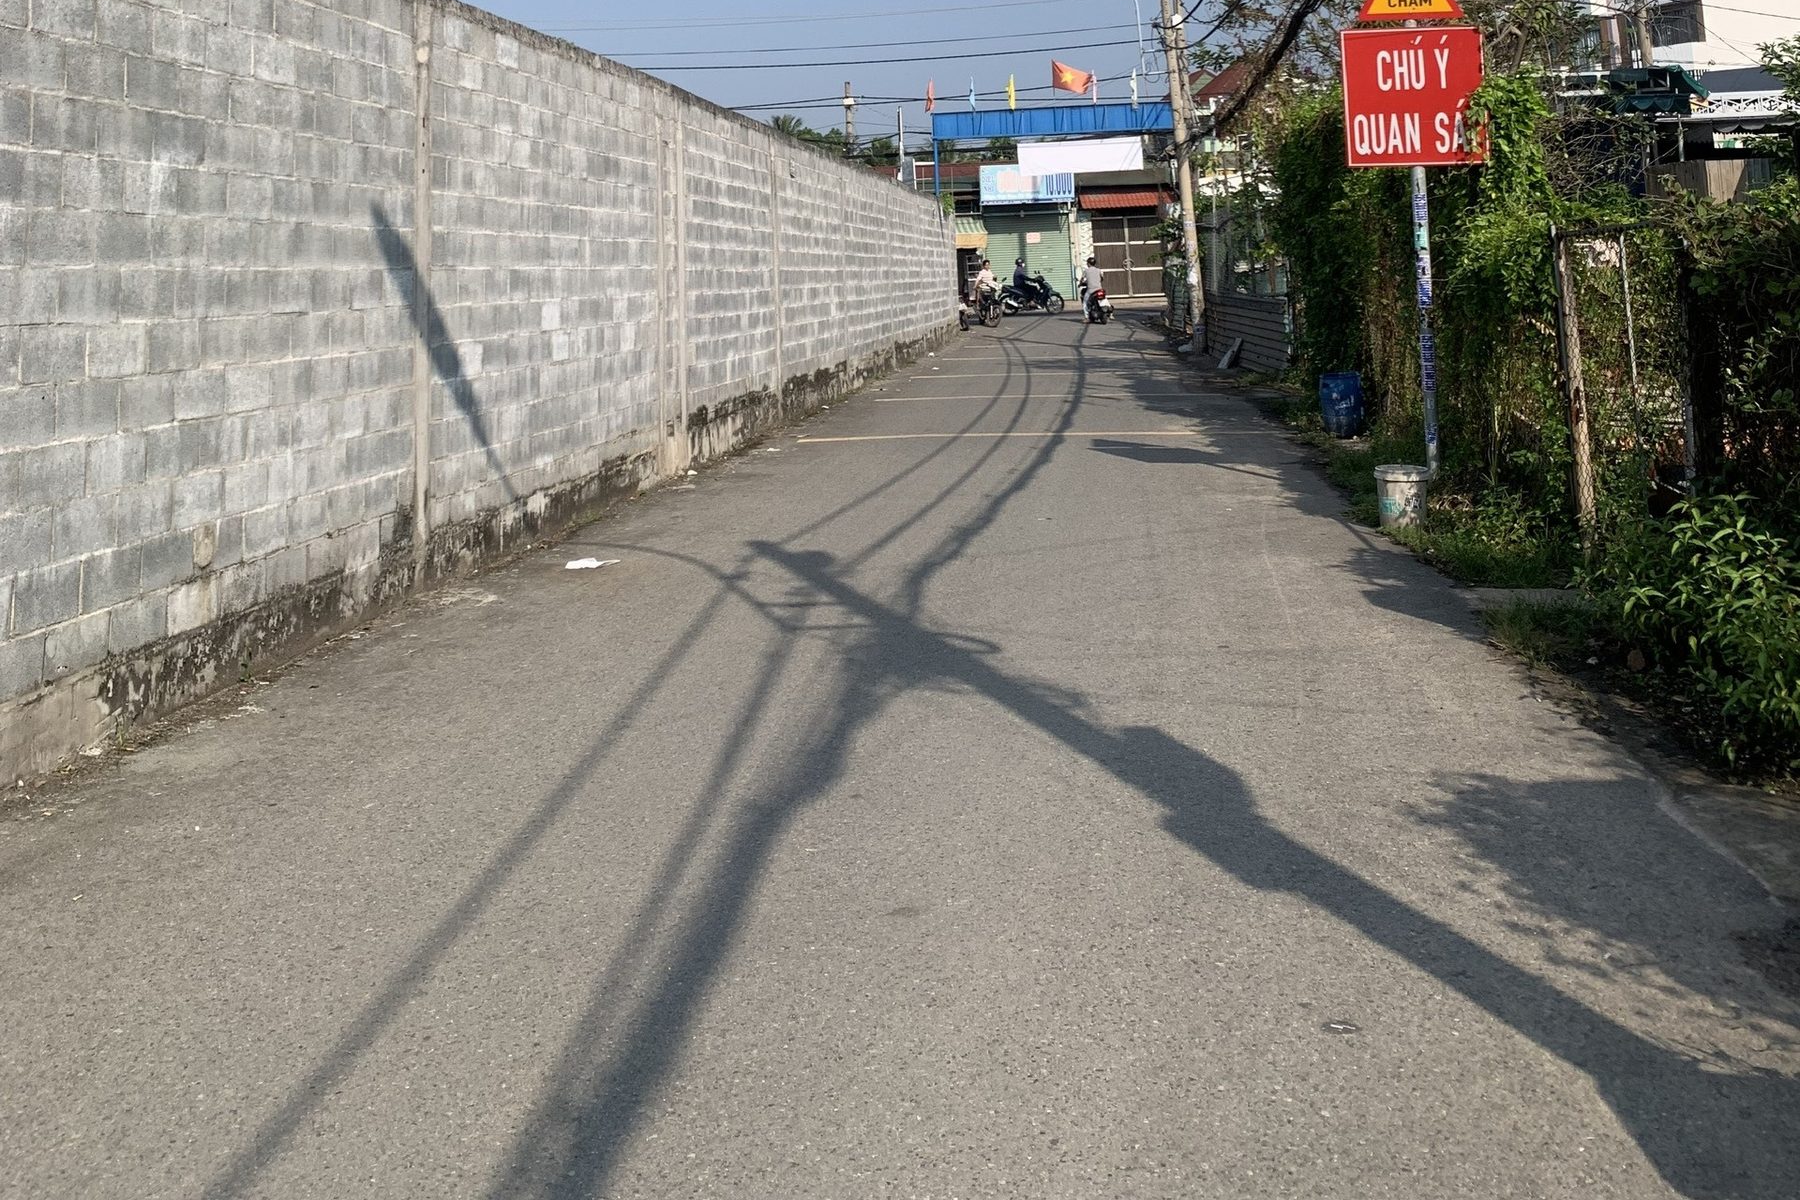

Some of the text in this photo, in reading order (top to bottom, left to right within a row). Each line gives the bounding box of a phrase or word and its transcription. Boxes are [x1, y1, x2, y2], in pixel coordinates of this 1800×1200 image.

[1376, 34, 1450, 92] CHÚ Ý
[1353, 98, 1479, 157] QUAN SÁ
